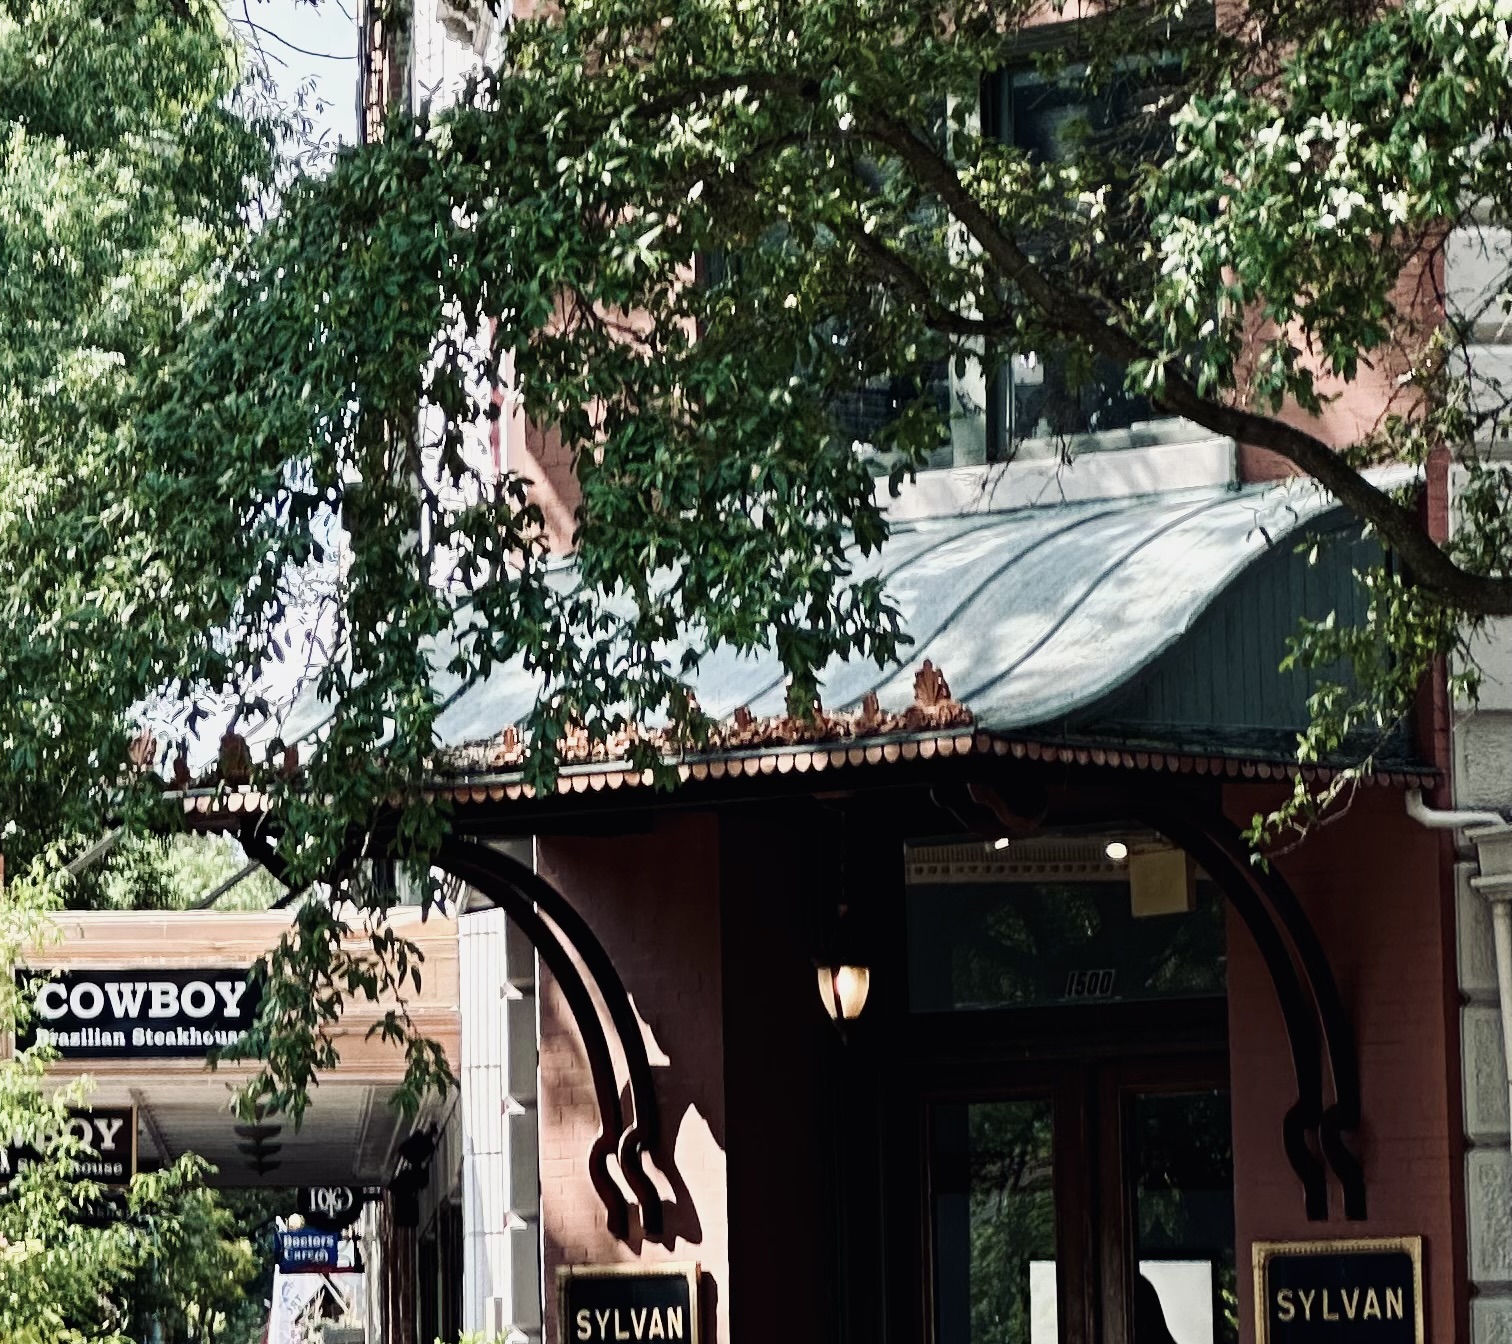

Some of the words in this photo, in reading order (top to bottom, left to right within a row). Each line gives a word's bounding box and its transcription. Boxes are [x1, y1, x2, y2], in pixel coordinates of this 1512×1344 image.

[37, 981, 246, 1019] COWBOY
[1065, 970, 1114, 996] 1500
[284, 1235, 334, 1249] Doctors
[1274, 1286, 1404, 1322] SYLVAN
[576, 1306, 684, 1341] SYLVAN
